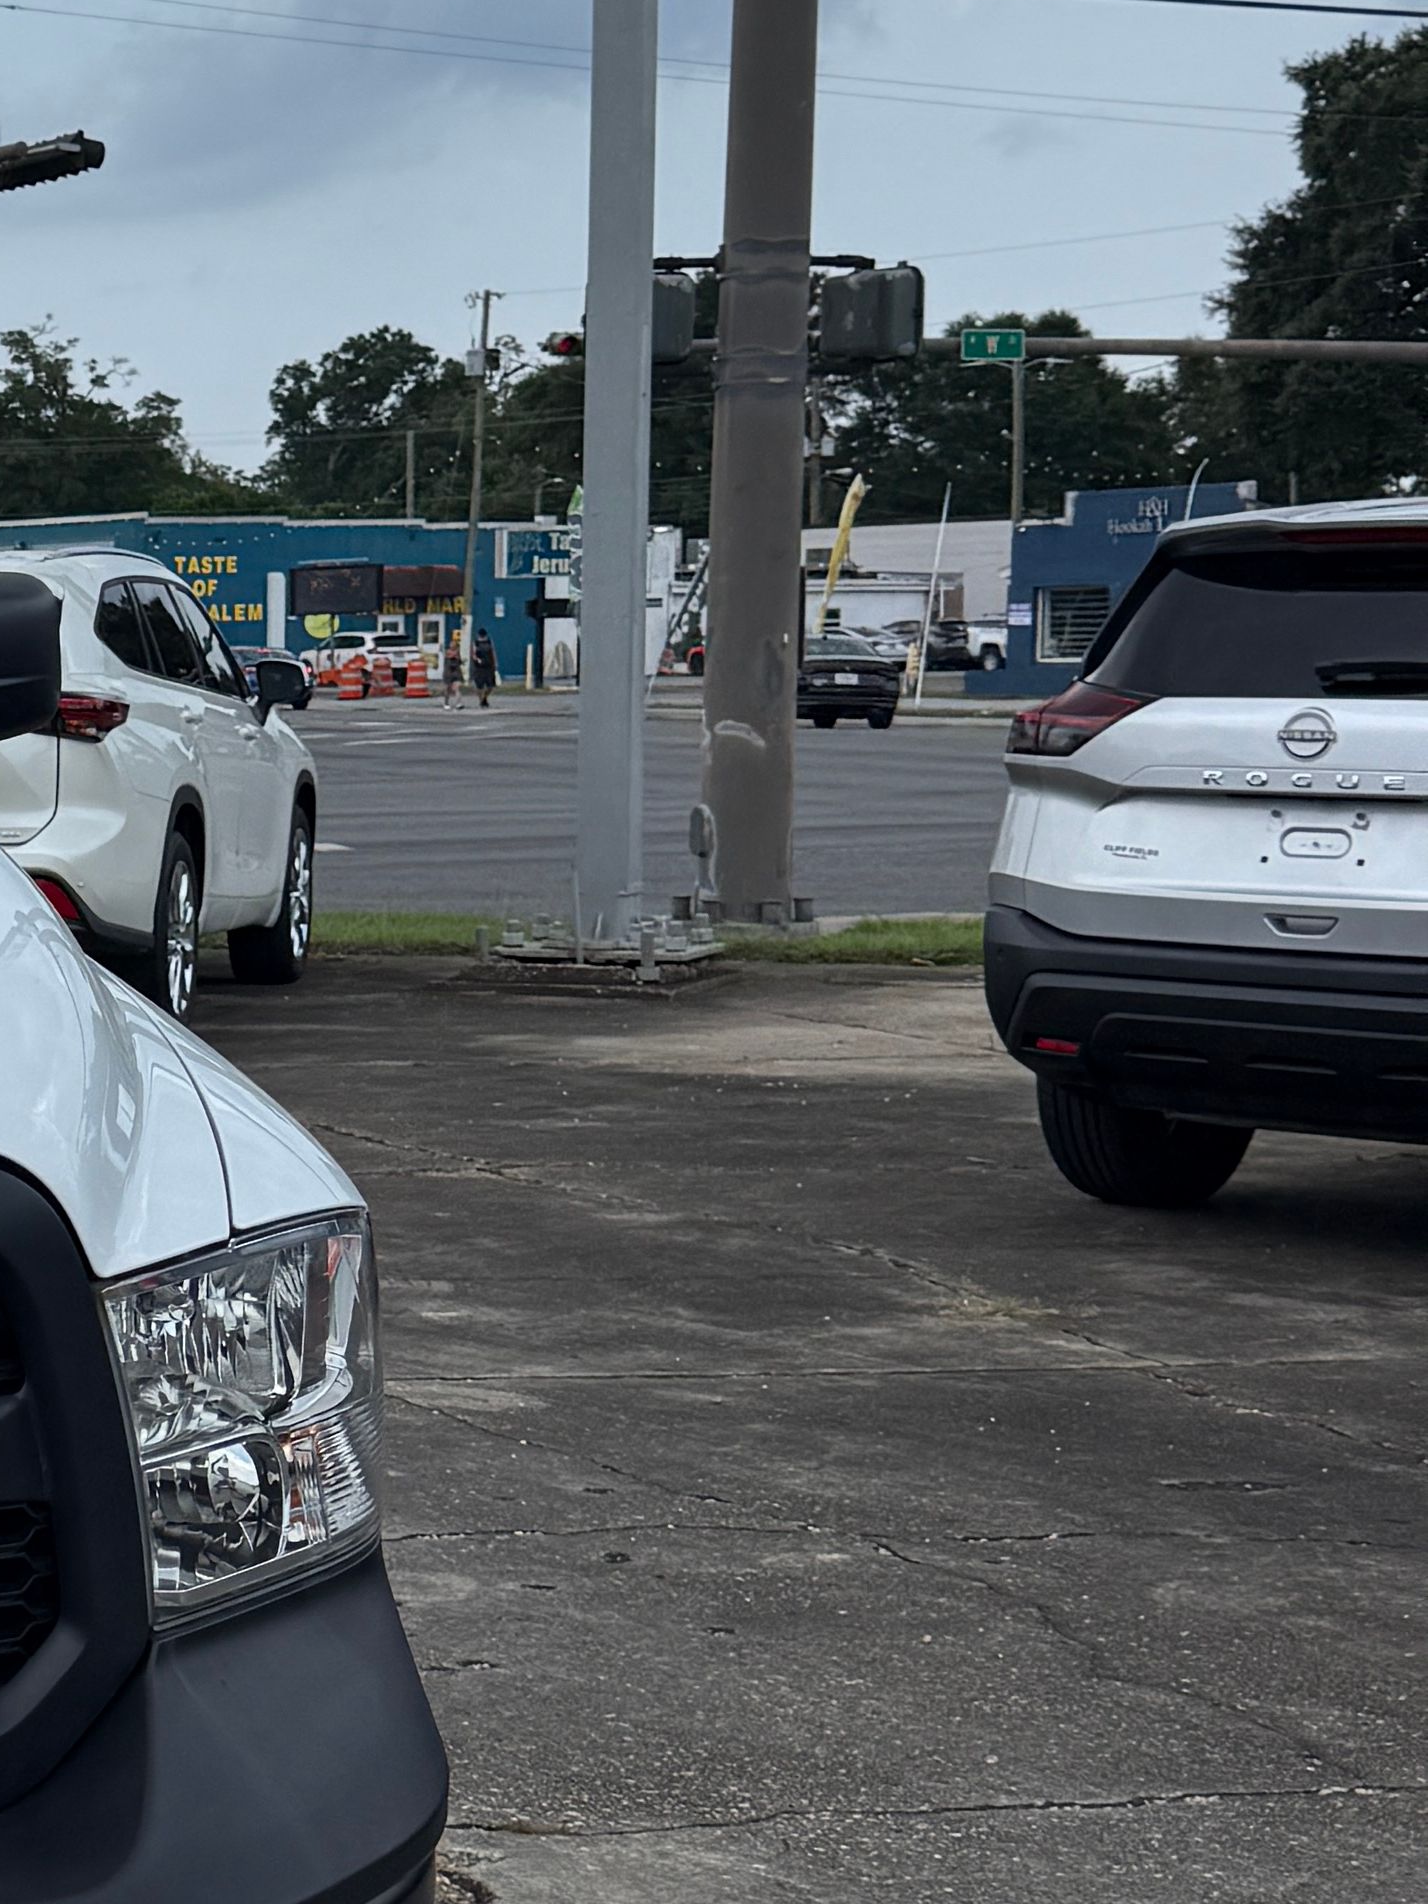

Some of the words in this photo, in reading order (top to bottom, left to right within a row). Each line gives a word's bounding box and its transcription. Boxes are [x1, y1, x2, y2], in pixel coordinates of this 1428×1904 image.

[548, 532, 571, 550] Ta
[174, 556, 238, 574] TASTE
[532, 556, 570, 574] Jeru
[192, 579, 218, 598] OF
[208, 603, 263, 621] ALEM
[383, 598, 416, 614] RLD
[427, 596, 465, 613] MAR
[1278, 729, 1336, 741] NISSAN
[1202, 770, 1406, 791] ROGUE
